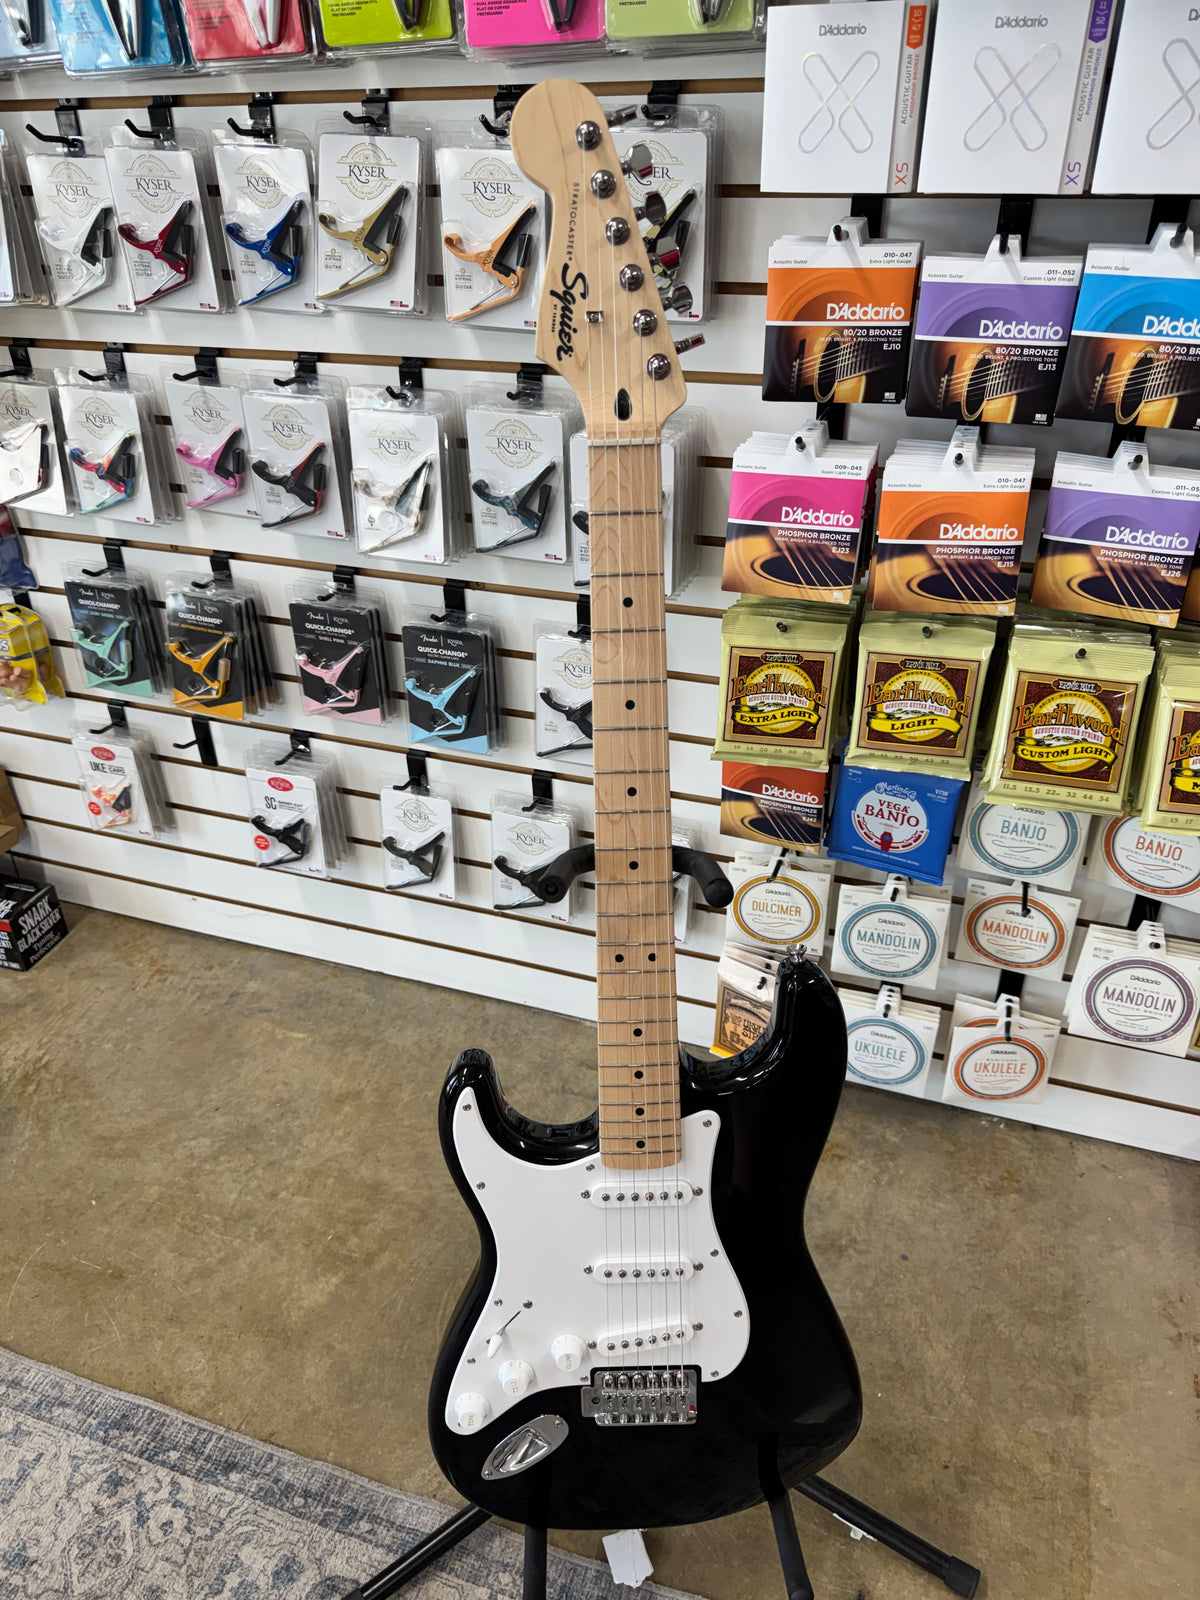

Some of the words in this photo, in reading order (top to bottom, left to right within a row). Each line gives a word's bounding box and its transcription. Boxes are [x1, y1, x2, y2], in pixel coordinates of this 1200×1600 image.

[913, 9, 922, 17] 10
[1095, 16, 1106, 25] 52
[818, 23, 868, 38] D'Addario
[912, 24, 921, 32] 47
[994, 14, 1049, 31] D'Addario
[905, 54, 914, 84] GUITAR
[1077, 79, 1089, 123] ACOUSTIC
[1083, 47, 1095, 78] GUITAR
[1085, 76, 1097, 116] PHOSPHOR
[1093, 47, 1103, 76] BRONZE
[900, 84, 911, 125] ACOUSTIC
[908, 81, 917, 119] PHOSPHOR
[347, 164, 389, 184] KYSER
[894, 161, 909, 186] XS
[1064, 161, 1082, 187] XS
[54, 183, 90, 203] KYSER
[134, 177, 175, 198] KYSER
[245, 174, 281, 195] KYSER
[472, 181, 516, 201] KYSER
[566, 182, 580, 258] STRATOCASTER
[549, 262, 589, 362] Squier
[826, 302, 905, 320] D'Addario
[843, 329, 867, 337] 80/20
[979, 319, 1063, 340] D'Addario
[995, 347, 1021, 355] 80/20
[1023, 348, 1059, 356] BRONZE
[1159, 345, 1187, 354] 80/20
[1037, 363, 1056, 371] EJ13
[5, 405, 32, 421] KYSER
[84, 413, 117, 429] KYSER
[192, 407, 225, 423] KYSER
[271, 422, 307, 438] KYSER
[377, 438, 413, 455] KYSER
[496, 437, 533, 455] KYSER
[781, 506, 854, 527] D'Addario
[778, 529, 818, 539] PHOSPHOR
[819, 533, 852, 541] BRONZE
[939, 523, 1018, 540] D'Addario
[1105, 526, 1189, 549] D'Addario
[936, 547, 980, 555] PHOSPHOR
[1100, 549, 1146, 561] PHOSPHOR
[1148, 554, 1185, 565] BRONZE
[1139, 561, 1166, 569] BALANCED
[1161, 569, 1181, 577] EJ26
[729, 674, 828, 708] Earthwood
[864, 681, 971, 718] Earthwood
[748, 695, 770, 703] ACOUSTIC
[788, 696, 808, 707] STRINGS
[885, 702, 908, 710] ACOUSTIC
[928, 704, 949, 715] STRINGS
[1090, 699, 1106, 716] ALLOY
[740, 713, 777, 723] EXTRA
[780, 709, 814, 720] LIGHT
[890, 718, 938, 731] LIGHT
[1012, 703, 1128, 747] Earthwood
[1034, 726, 1059, 735] ACOUSTIC
[1061, 727, 1079, 735] GUITAR
[1081, 729, 1104, 743] STRINGS
[1020, 748, 1070, 759] CUSTOM
[1073, 745, 1112, 759] LIGHT
[89, 761, 108, 773] UKE
[762, 783, 819, 804] D'Addario
[264, 796, 277, 810] SC
[760, 799, 792, 810] PHOSPHOR
[793, 805, 818, 814] BRONZE
[878, 799, 909, 813] VEGA
[403, 810, 430, 823] KYSER
[864, 804, 920, 828] BANJO
[1001, 820, 1047, 841] BANJO
[516, 833, 547, 846] KYSER
[1135, 835, 1183, 861] BANJO
[18, 895, 52, 935] SNARK
[752, 900, 801, 917] DULCIMER
[17, 925, 42, 953] BLACK
[39, 908, 62, 935] SILVER
[878, 918, 906, 927] D'Addario
[856, 929, 921, 950] MANDOLIN
[982, 919, 1049, 944] MANDOLIN
[1130, 975, 1161, 986] D'Addario
[1103, 986, 1177, 1013] MANDOLIN
[854, 1040, 907, 1062] UKULELE
[974, 1062, 1027, 1074] UKULELE
